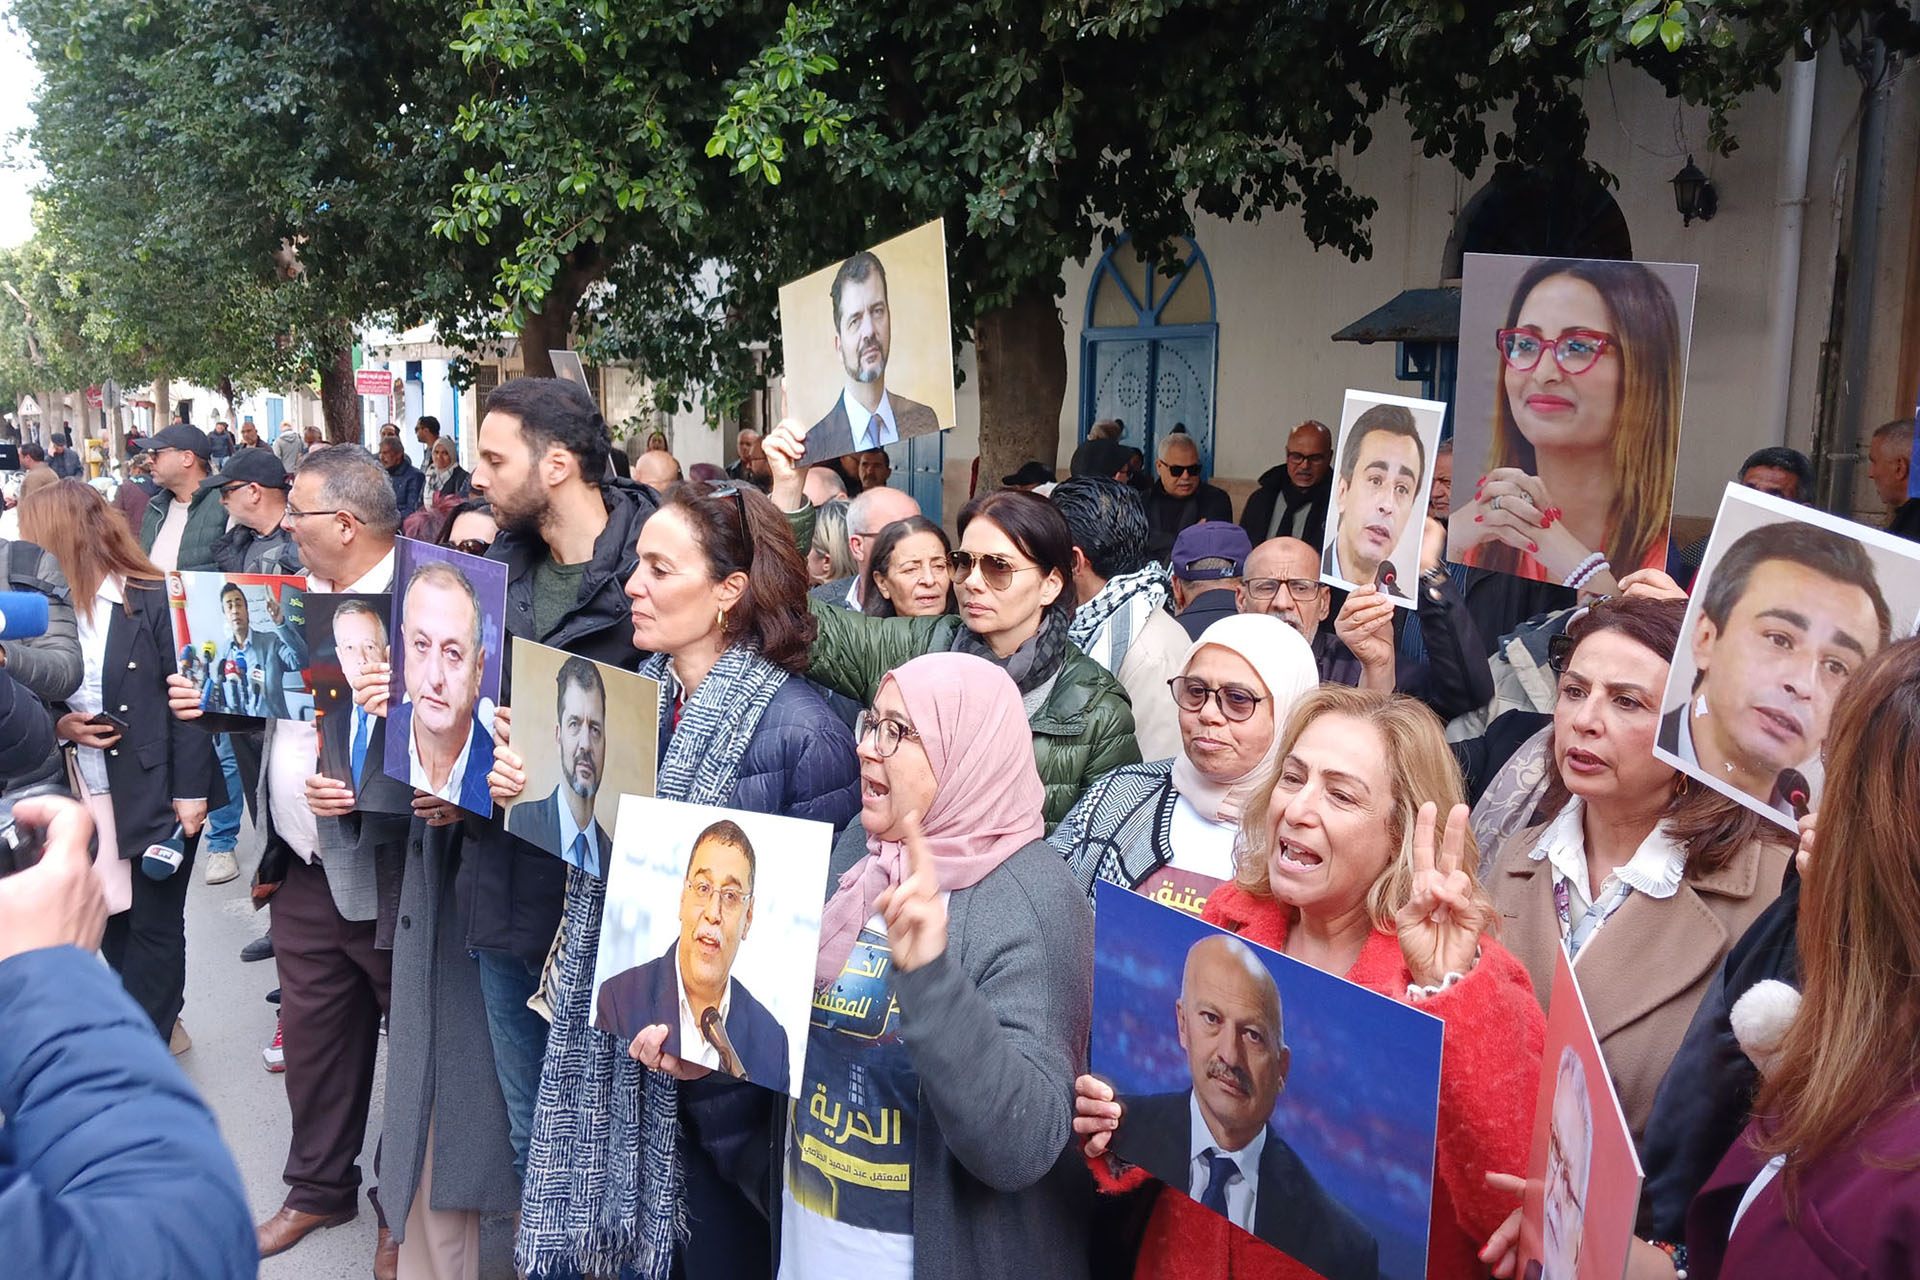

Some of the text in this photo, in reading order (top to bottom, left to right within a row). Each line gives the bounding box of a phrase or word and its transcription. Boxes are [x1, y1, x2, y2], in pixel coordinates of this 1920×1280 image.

[810, 1082, 901, 1145] الحرية
[828, 1159, 852, 1174] الحميد
[852, 1168, 867, 1179] عبد
[869, 1172, 907, 1182] للمعتقل
